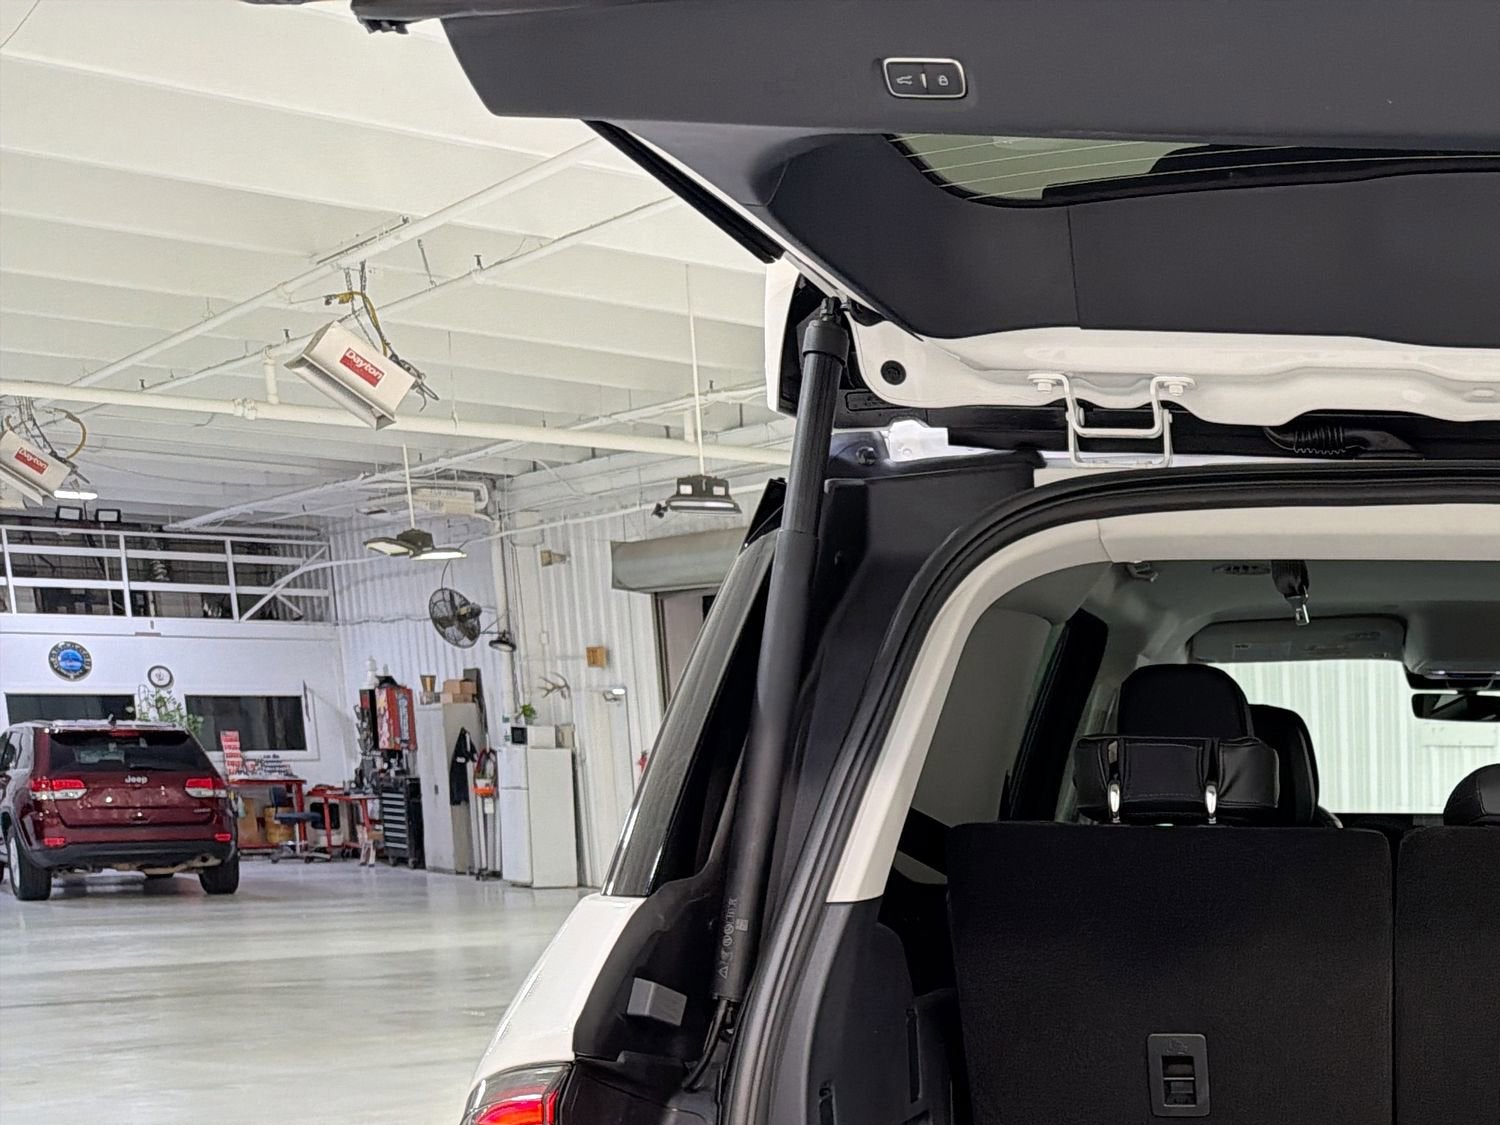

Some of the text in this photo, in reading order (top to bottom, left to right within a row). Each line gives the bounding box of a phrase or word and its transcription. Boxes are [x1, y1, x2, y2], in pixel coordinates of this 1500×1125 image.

[345, 350, 383, 380] Dayton
[18, 448, 47, 469] Dayton
[124, 775, 148, 785] Jeep
